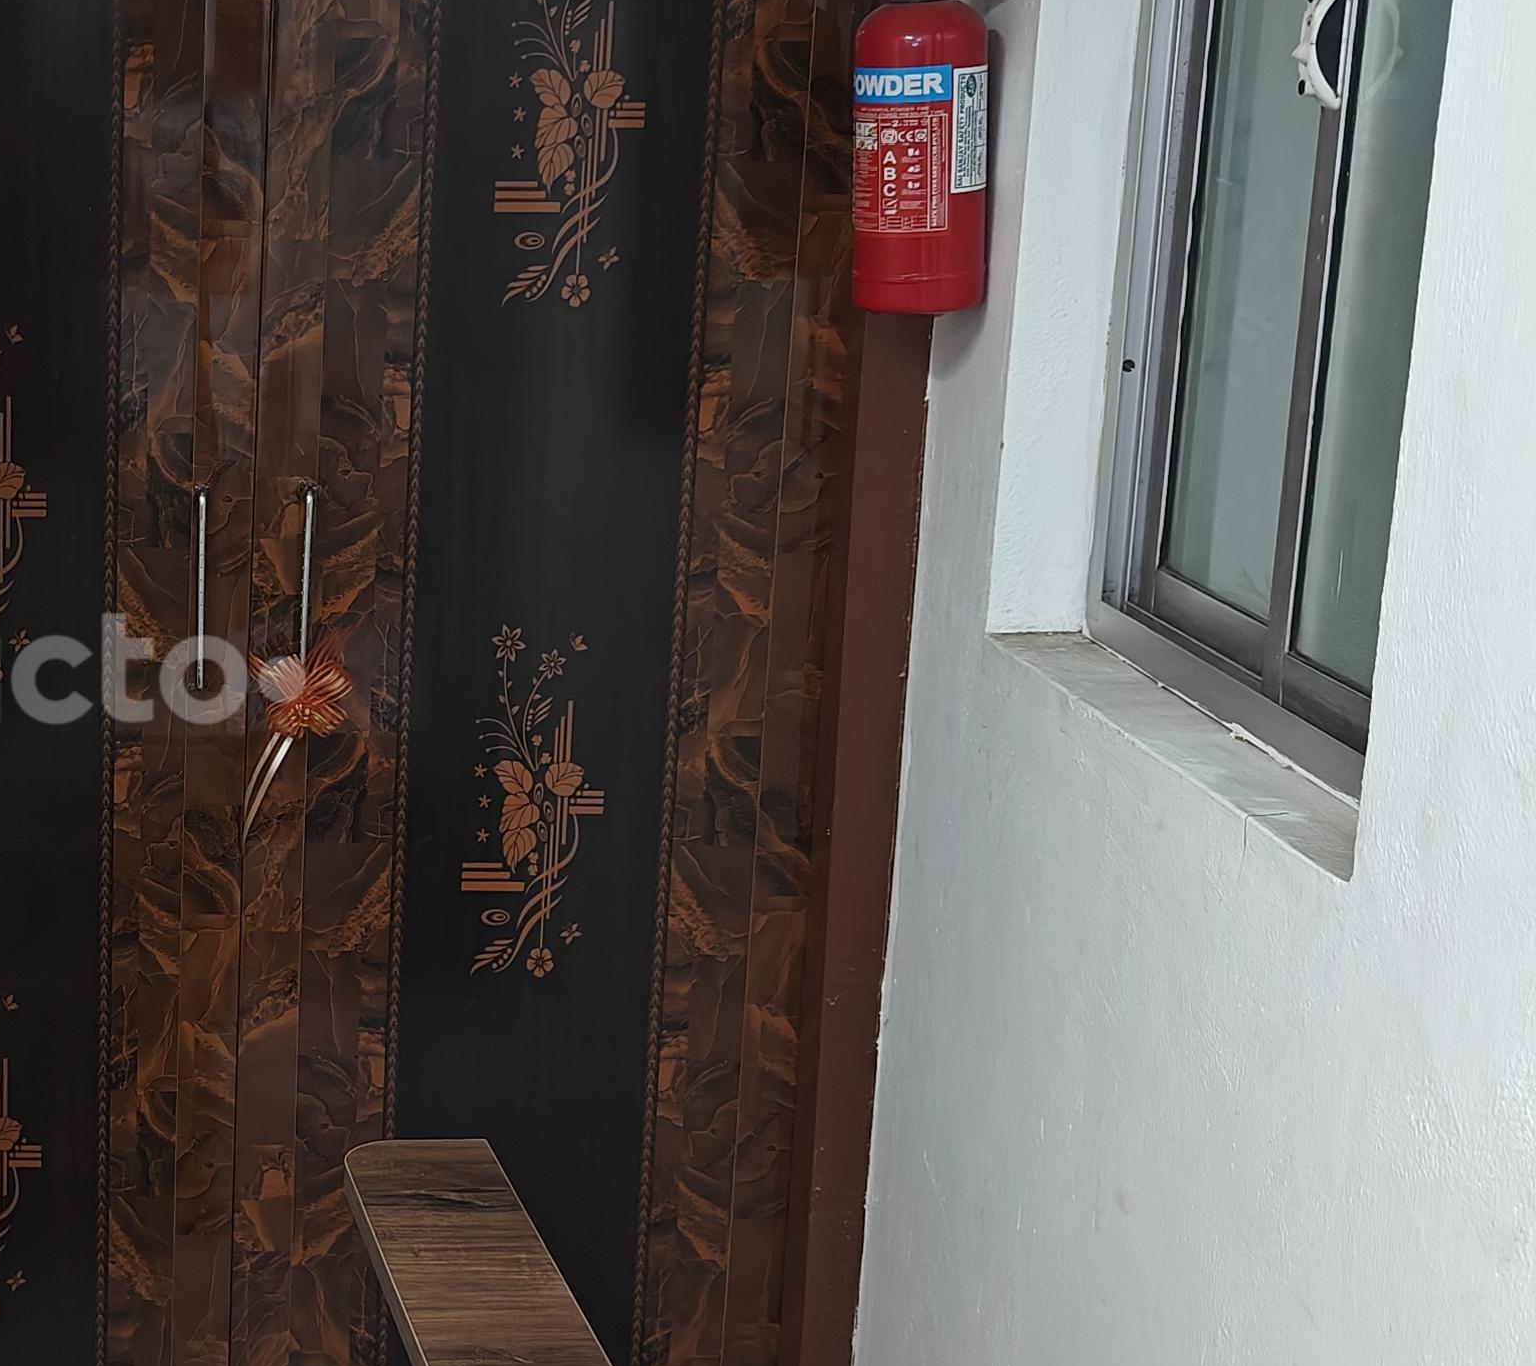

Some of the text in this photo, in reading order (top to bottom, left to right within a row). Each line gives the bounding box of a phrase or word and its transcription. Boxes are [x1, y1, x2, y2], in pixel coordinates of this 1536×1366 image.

[853, 72, 944, 97] OWDER
[883, 150, 897, 165] A
[883, 167, 897, 181] B
[883, 183, 896, 197] C
